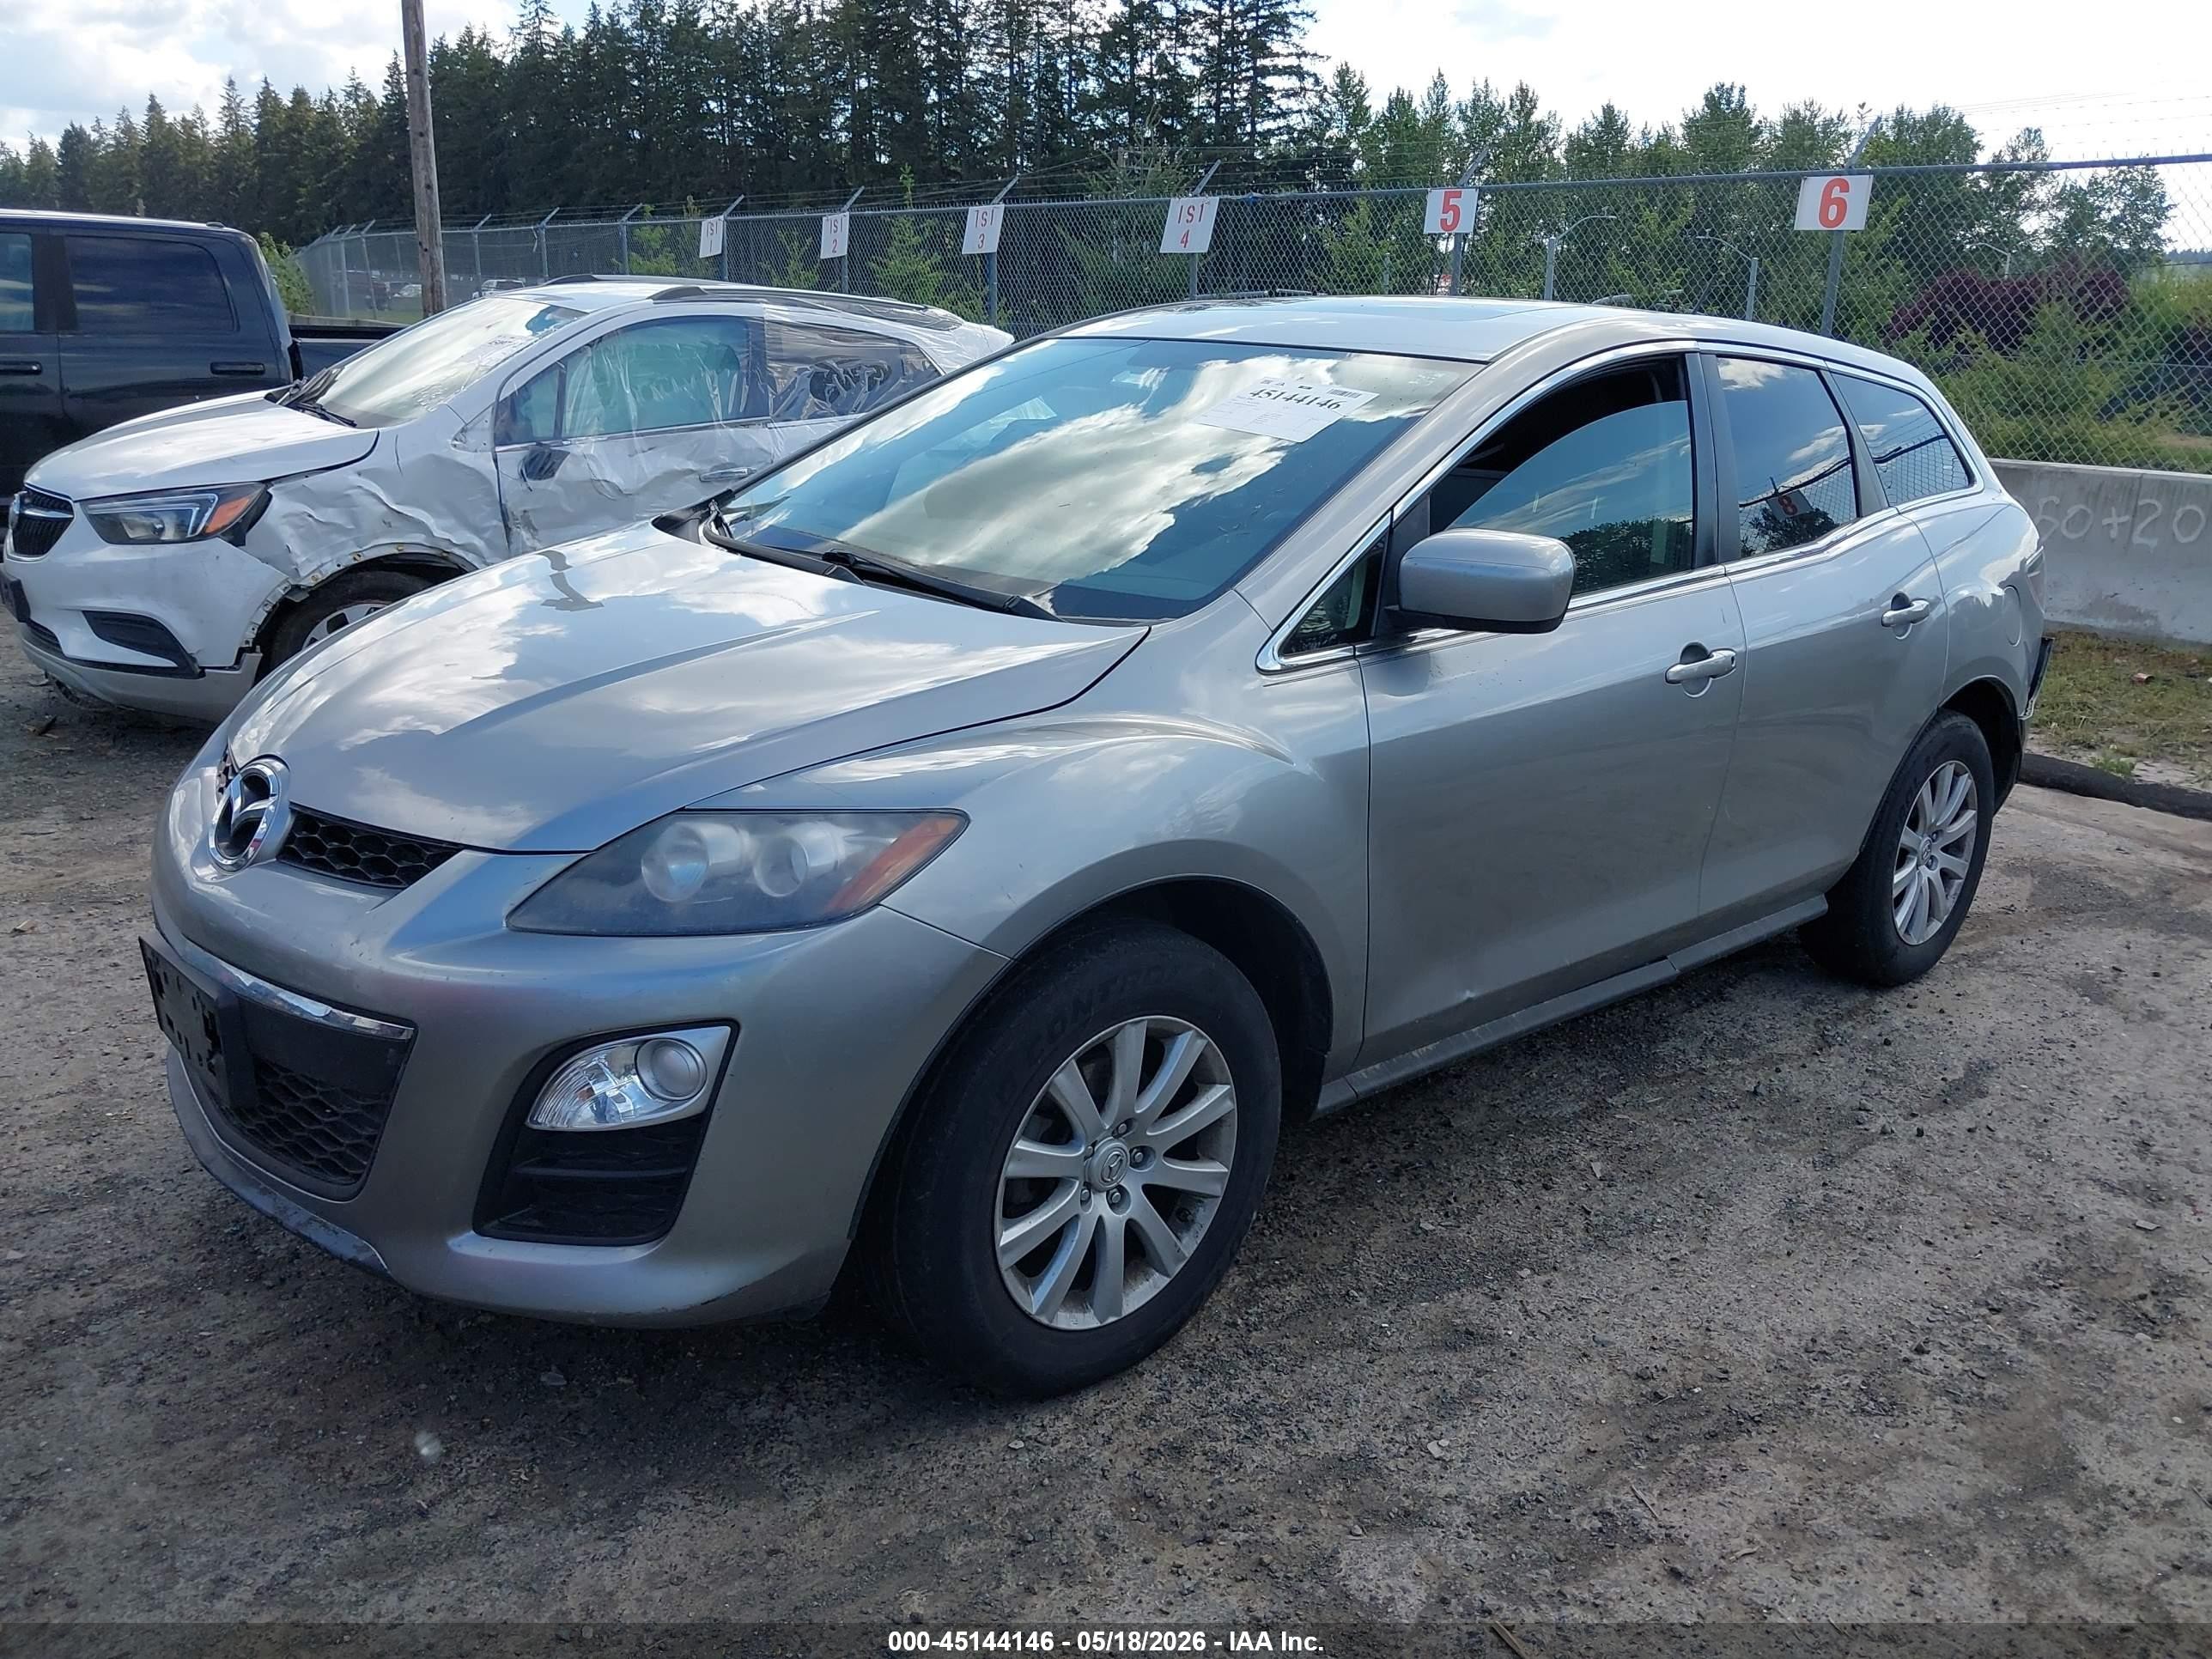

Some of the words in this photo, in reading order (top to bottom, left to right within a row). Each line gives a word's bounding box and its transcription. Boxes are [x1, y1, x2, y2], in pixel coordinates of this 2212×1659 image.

[1439, 190, 1463, 232] 5
[1818, 177, 1850, 229] 6
[831, 238, 838, 253] 2
[977, 233, 985, 249] 3
[1180, 228, 1190, 249] 4
[1249, 388, 1346, 410] 45144146
